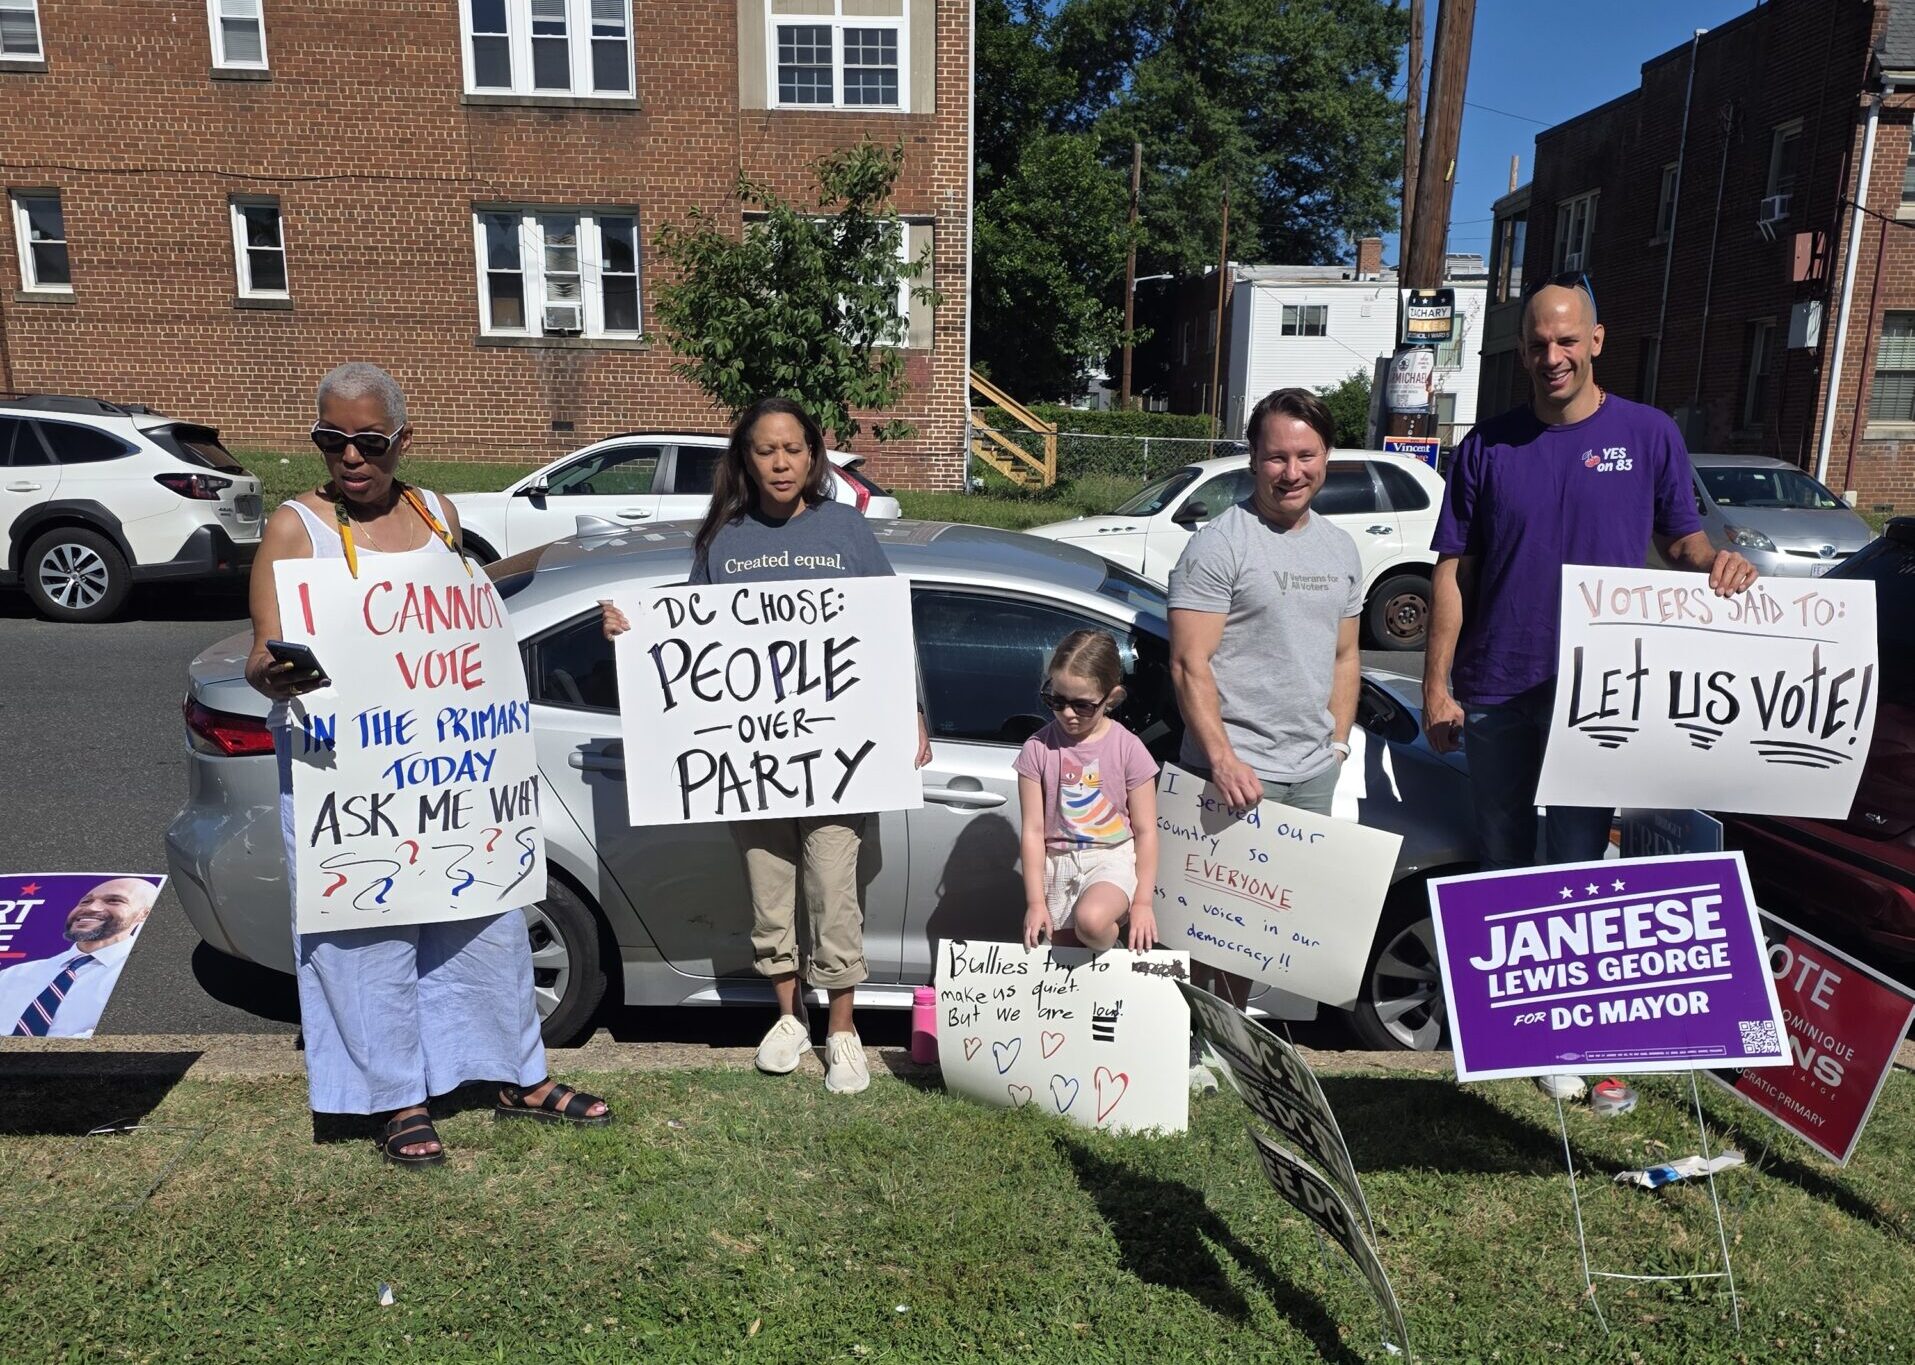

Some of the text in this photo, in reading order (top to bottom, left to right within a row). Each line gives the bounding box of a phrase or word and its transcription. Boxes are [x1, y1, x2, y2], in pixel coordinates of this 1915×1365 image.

[1393, 442, 1430, 453] Vincent
[1597, 459, 1633, 472] on 83
[1603, 447, 1626, 460] YES
[725, 551, 846, 574] Created equal.
[1289, 573, 1338, 583] Veterans for
[1300, 583, 1329, 591] Voters
[298, 581, 503, 635] I CANNOT
[653, 588, 845, 629] DC CHOSE:
[1578, 579, 1713, 625] VOTERS
[1793, 592, 1846, 627] TO:
[395, 642, 486, 691] VOTE
[647, 635, 861, 713] PEOPLE
[302, 699, 530, 755] IN THE PRIMARY
[382, 748, 497, 790] TODAY
[675, 739, 877, 821] PARTY
[310, 774, 539, 848] ASK ME WHY
[1163, 772, 1180, 795] I
[1278, 823, 1325, 844] our
[1157, 816, 1269, 864] country so
[1184, 853, 1293, 909] EVERYONE
[1178, 896, 1188, 907] a
[1203, 904, 1246, 926] voice
[1264, 919, 1278, 935] in
[1292, 933, 1320, 947] our
[1469, 894, 1727, 971] JANEESE
[949, 940, 1029, 979] Bullies
[1043, 949, 1075, 983] try
[1089, 953, 1110, 973] to
[1487, 942, 1731, 998] LEWIS GEORGE
[1766, 938, 1842, 1010] OTE
[941, 979, 1080, 1012] make us quiet.
[948, 1004, 981, 1027] But
[1037, 1007, 1075, 1020] are
[1513, 991, 1710, 1031] FOR DC MAYOR
[1782, 1009, 1855, 1062] OMINIQUE
[1789, 1034, 1845, 1087] NS
[1734, 1066, 1778, 1097] OCRATIC
[1777, 1091, 1827, 1128] PRIMARY
[1300, 1178, 1346, 1235] DC
